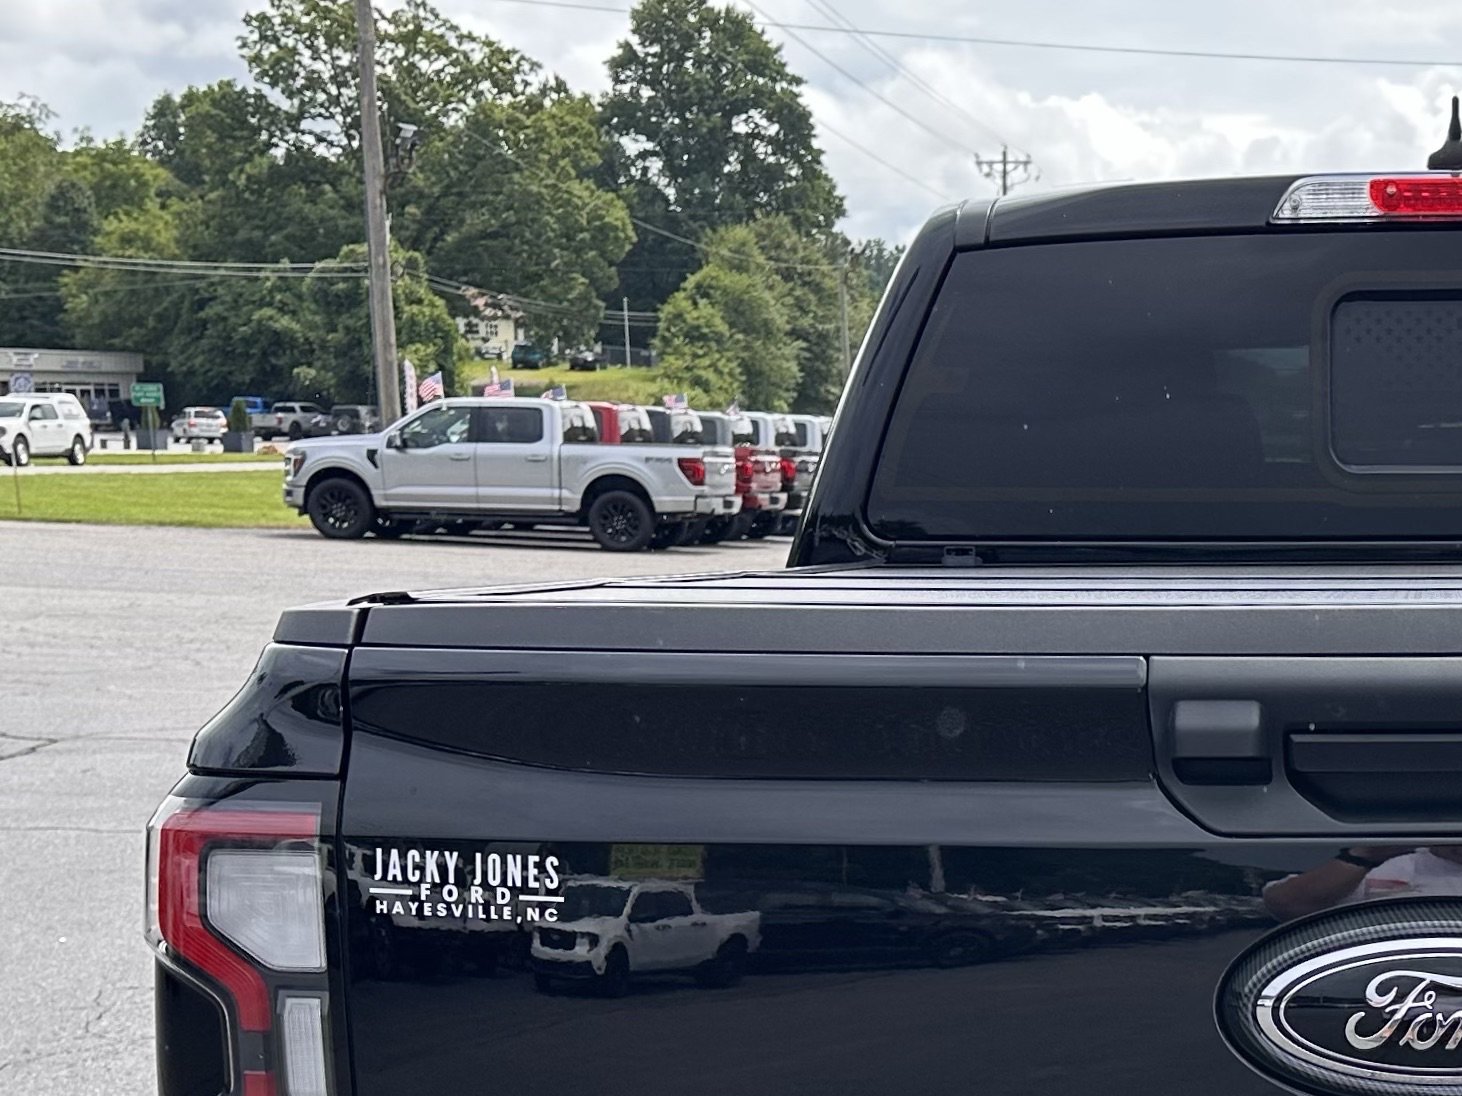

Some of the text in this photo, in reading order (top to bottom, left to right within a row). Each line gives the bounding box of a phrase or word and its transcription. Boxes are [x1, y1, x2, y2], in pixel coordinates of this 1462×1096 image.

[373, 847, 560, 889] JACKY JONES
[420, 884, 511, 905] FORD
